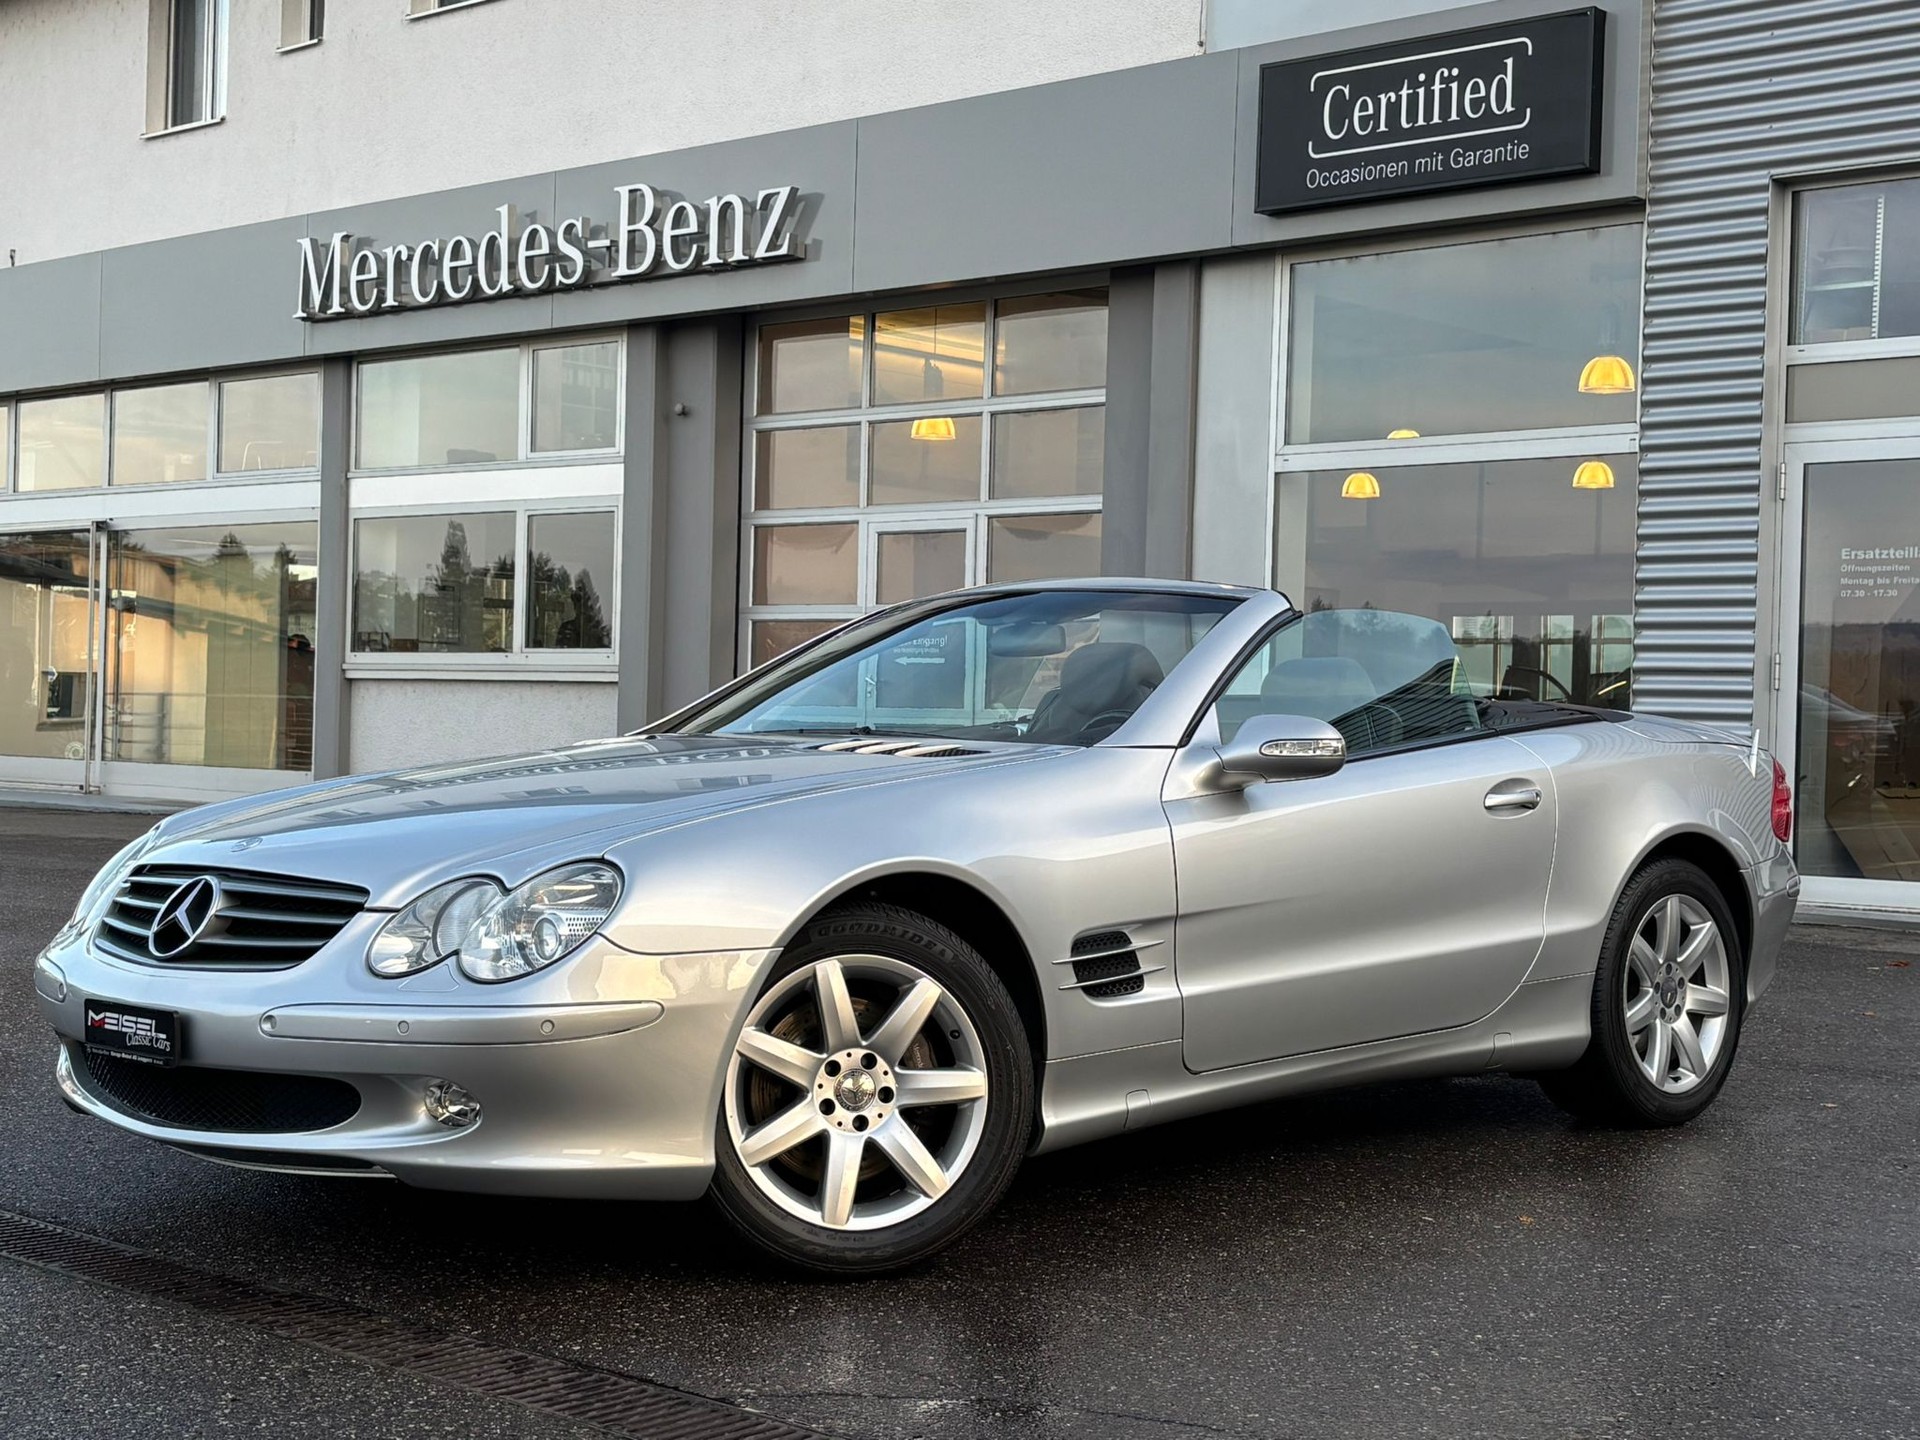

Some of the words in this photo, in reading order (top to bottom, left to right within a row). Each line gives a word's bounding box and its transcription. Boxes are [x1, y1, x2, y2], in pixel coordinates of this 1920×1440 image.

[1322, 57, 1516, 141] Certified
[1306, 157, 1408, 190] Occasionen
[1414, 150, 1444, 174] mit
[1449, 140, 1530, 169] Garantie
[293, 183, 801, 321] Mercedes-Benz
[1842, 547, 1920, 559] Ersatzteill
[1840, 577, 1874, 586] Montag
[1877, 577, 1890, 585] bis
[88, 1010, 167, 1039] MEISEL
[126, 1033, 152, 1046] Classic
[153, 1035, 171, 1052] Cars
